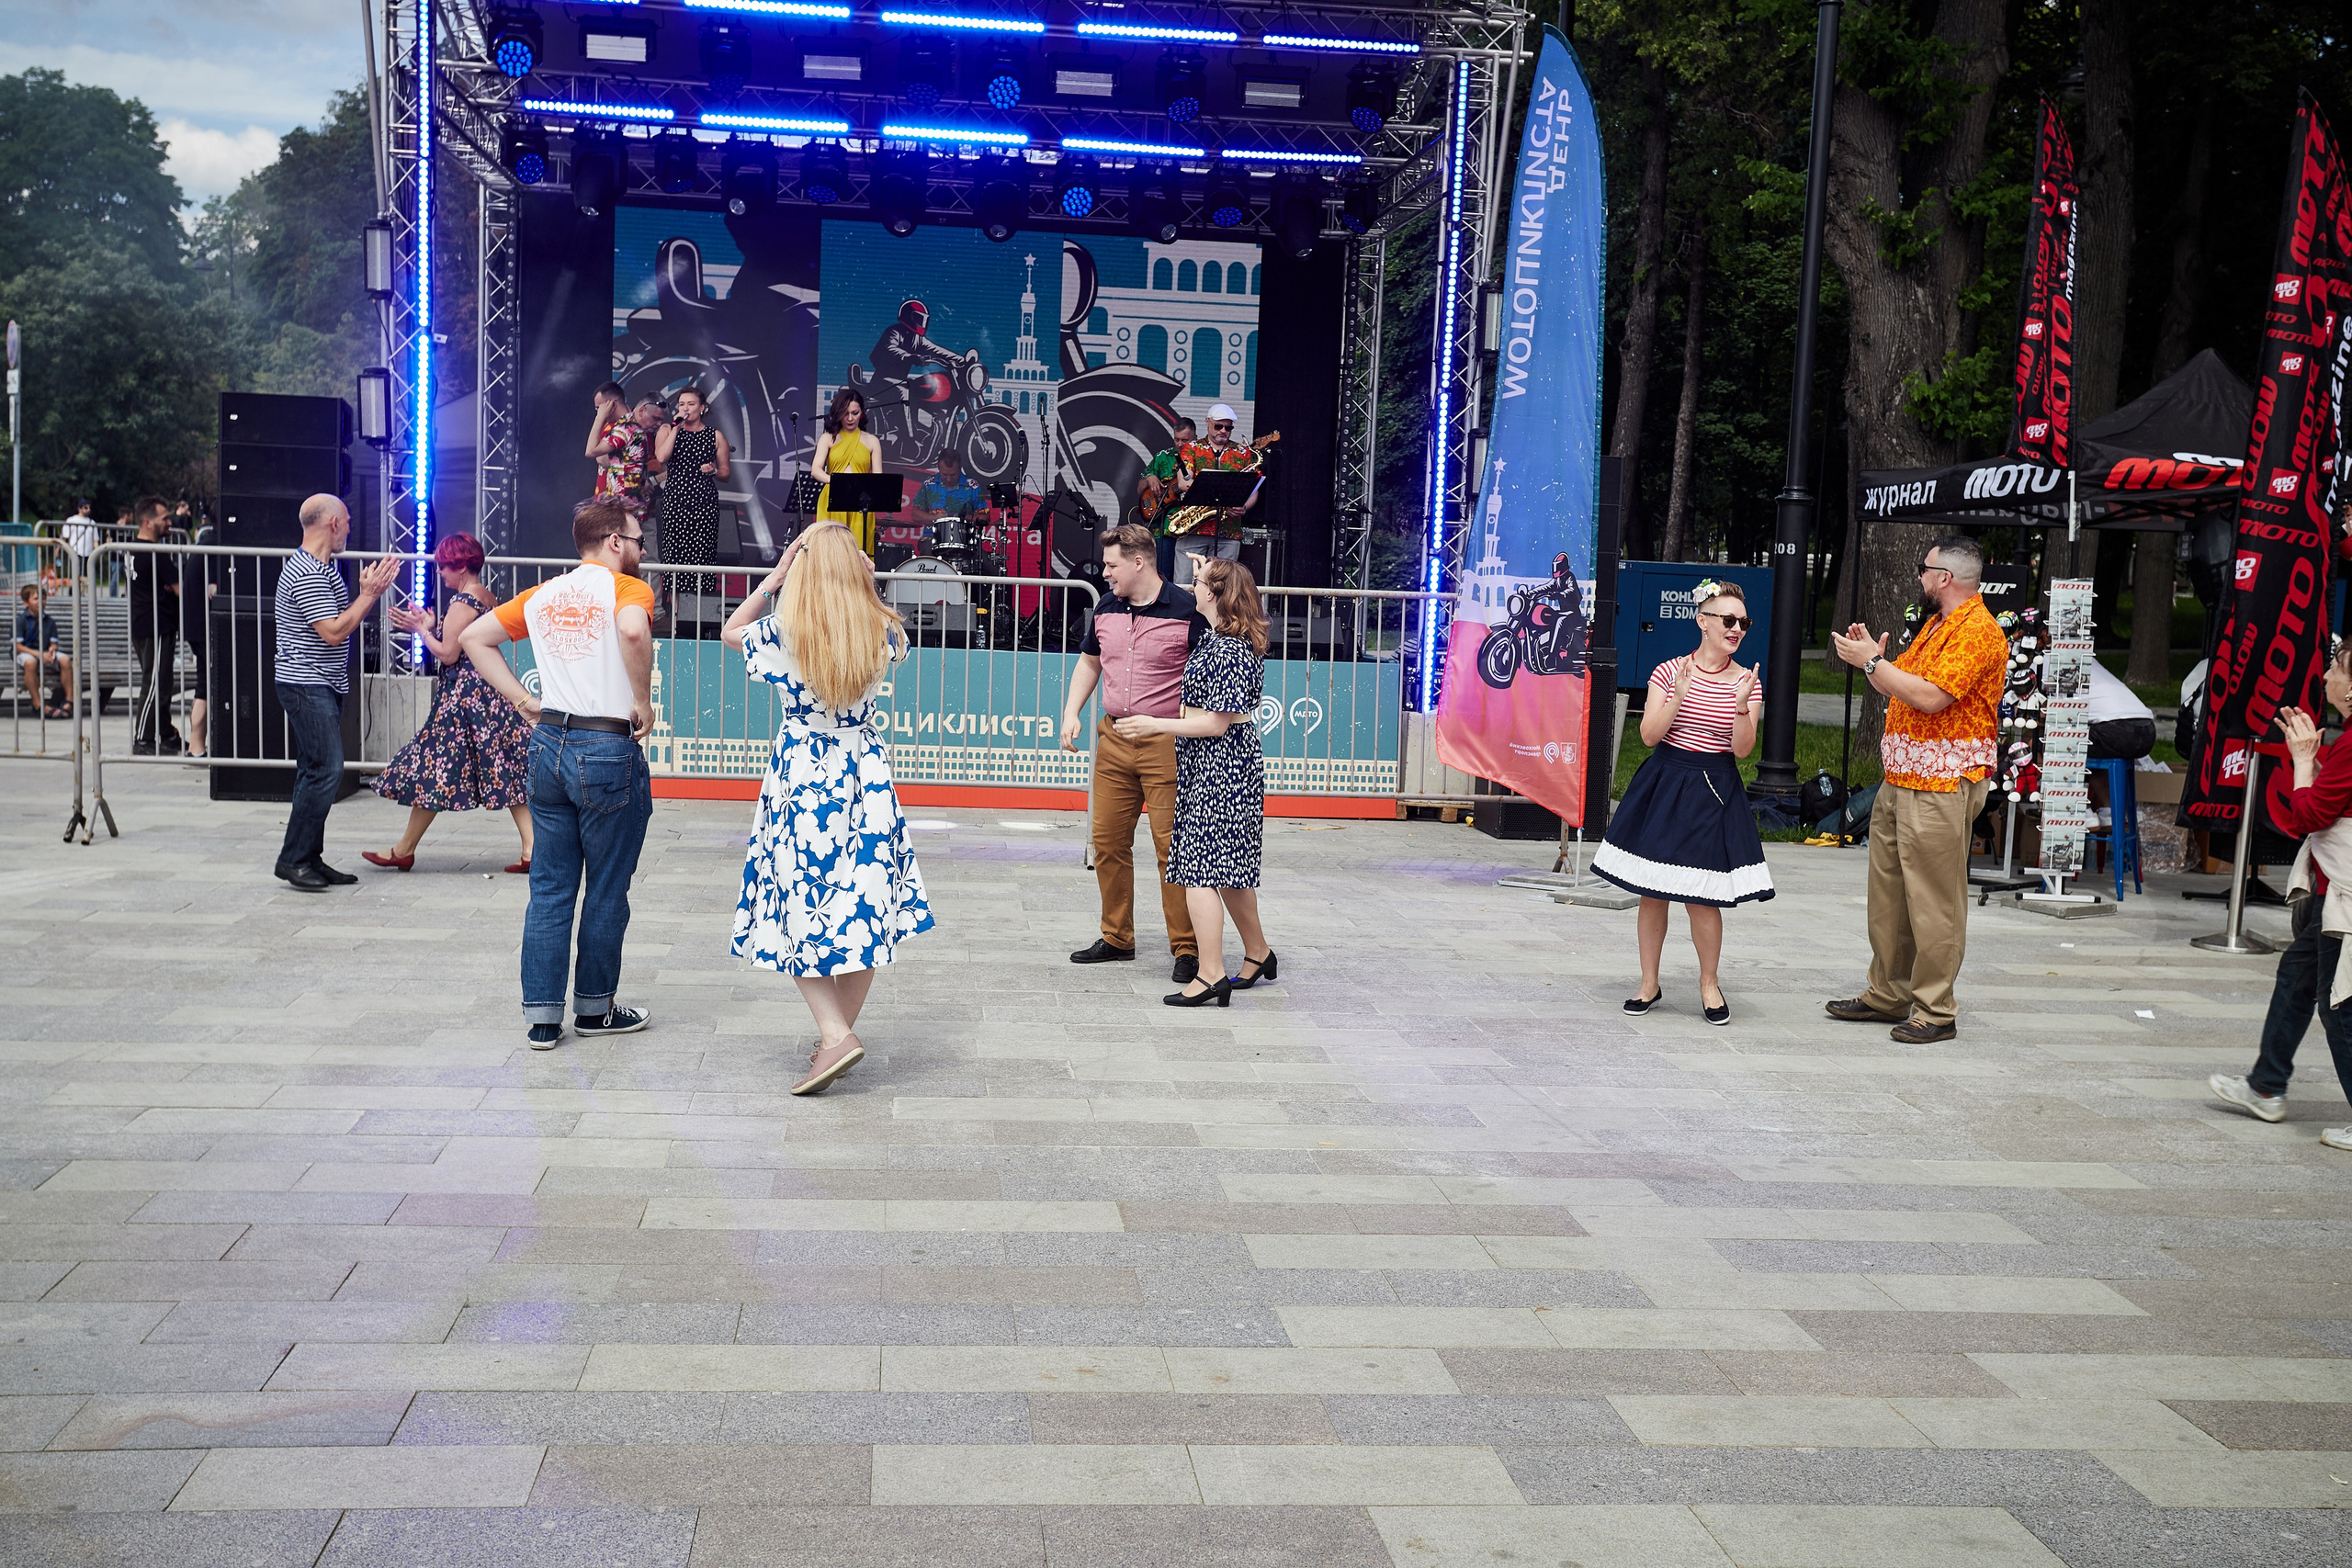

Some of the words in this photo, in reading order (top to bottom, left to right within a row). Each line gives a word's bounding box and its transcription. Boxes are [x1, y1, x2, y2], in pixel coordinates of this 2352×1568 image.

[1864, 480, 1937, 516] журнал
[1774, 543, 1796, 555] 08
[915, 563, 937, 573] Pearl
[1661, 590, 1694, 603] KOHL
[1675, 606, 1700, 620] SDM
[871, 710, 1054, 738] оциклиста
